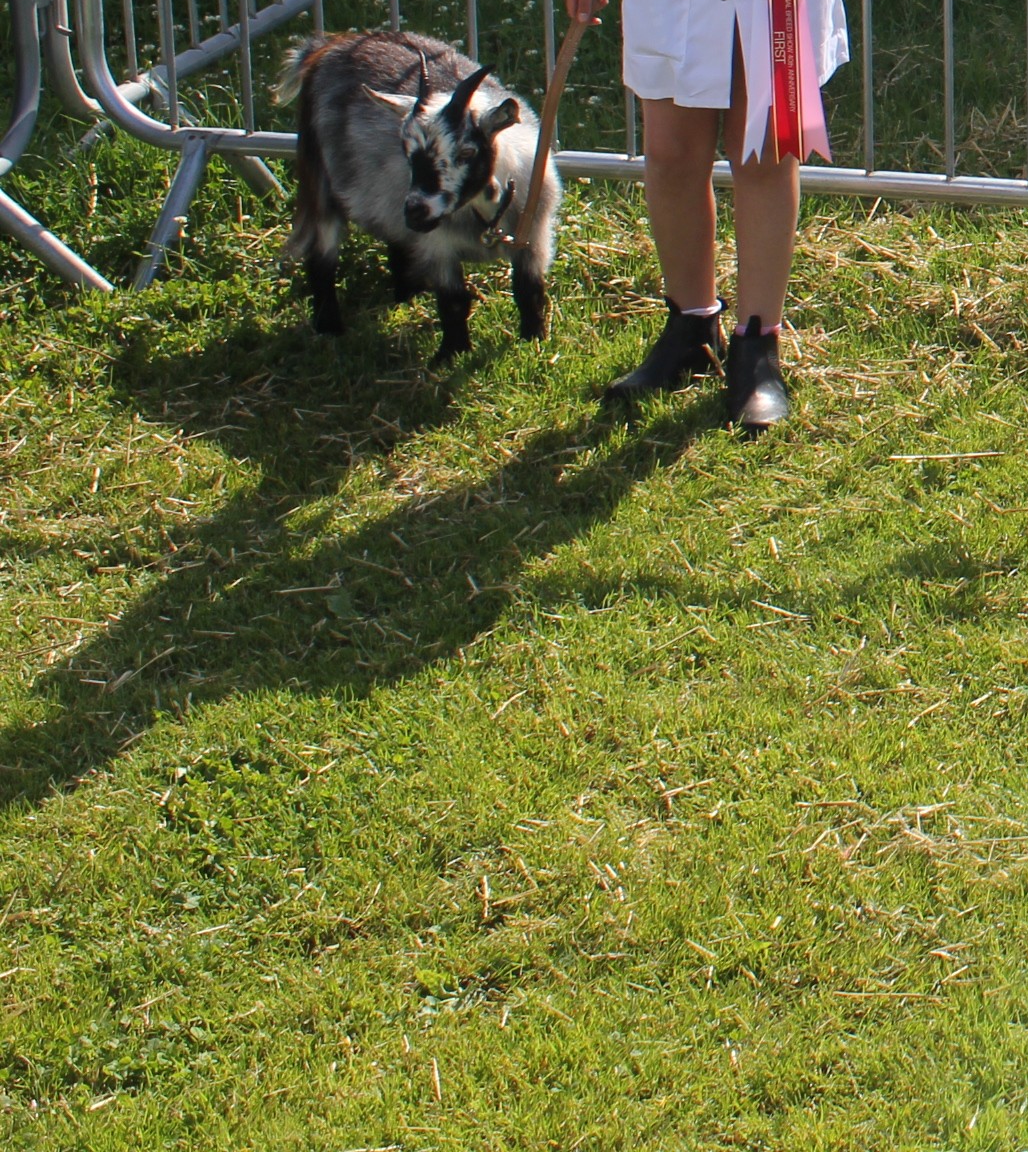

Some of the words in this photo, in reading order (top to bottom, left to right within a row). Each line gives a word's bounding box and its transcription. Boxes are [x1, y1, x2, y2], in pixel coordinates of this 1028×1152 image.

[773, 31, 786, 64] FIRST
[786, 33, 794, 54] SHOW
[787, 54, 795, 68] 40th
